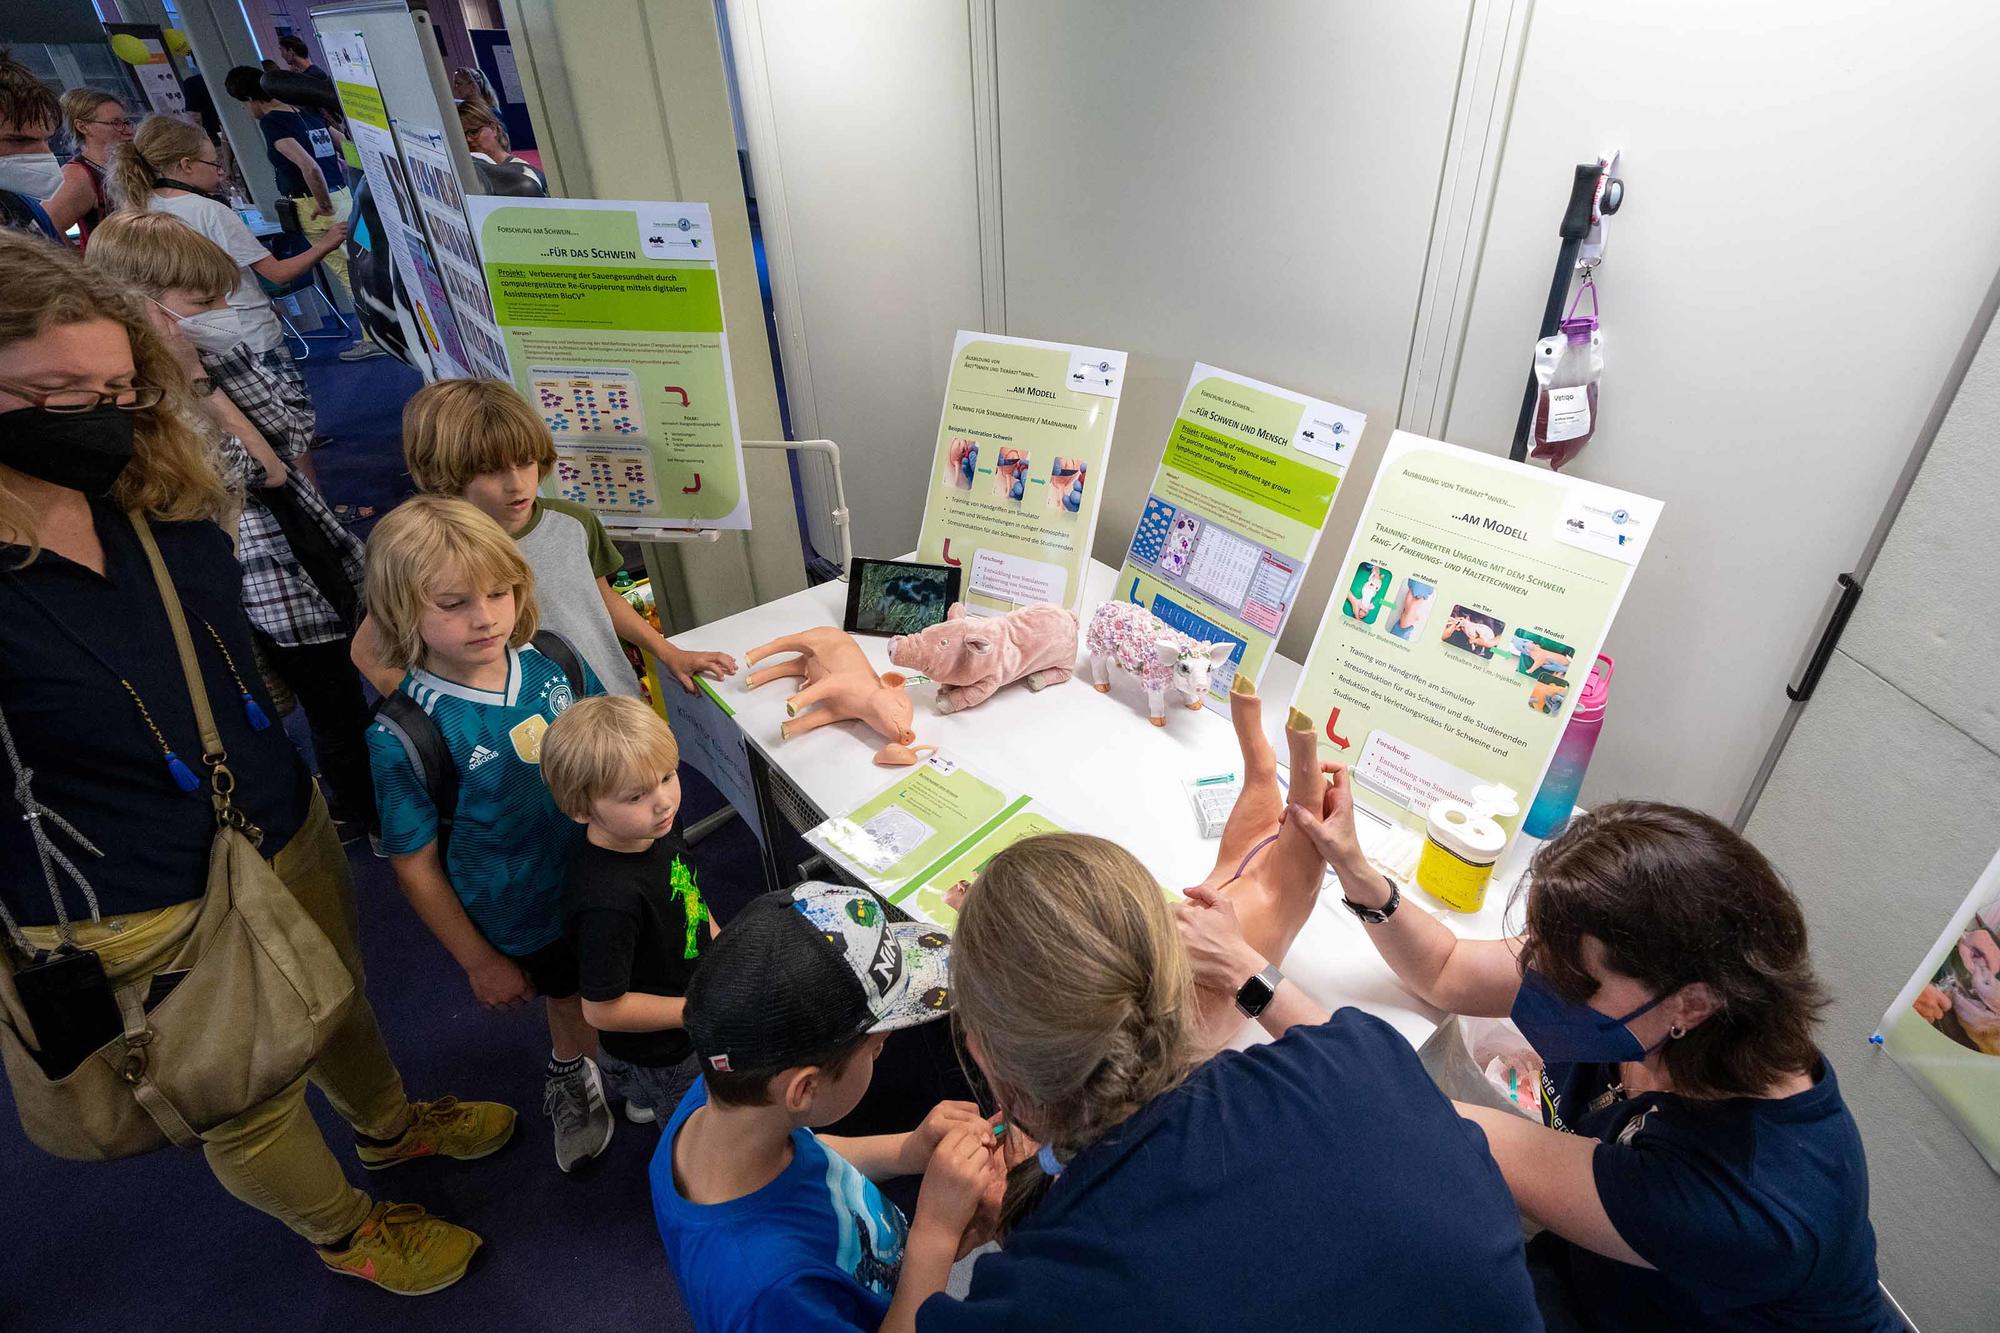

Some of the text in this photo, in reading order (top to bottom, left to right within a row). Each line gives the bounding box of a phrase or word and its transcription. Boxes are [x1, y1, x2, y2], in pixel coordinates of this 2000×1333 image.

[570, 250, 589, 258] DAS
[591, 248, 636, 260] SCHWEIN
[498, 269, 677, 282] Projekt: Verbesserung der Sauengesundheit durch
[501, 280, 687, 293] computergestützte Re-Gruppierung mittels digitalem
[503, 290, 559, 300] Assistenzsystem
[1027, 387, 1056, 399] MODELL
[952, 403, 975, 413] TRAINING
[975, 407, 986, 415] FÜR
[948, 424, 1013, 441] Beispiel: Kastration Schwein
[1209, 411, 1240, 429] SCHWEIN
[1240, 423, 1256, 435] UND
[1256, 428, 1288, 447] MENSCH
[1179, 434, 1187, 442] for
[1187, 437, 1204, 450] porcine
[1205, 445, 1231, 461] neutrophil
[1181, 424, 1200, 438] Projekt:
[1200, 431, 1229, 449] Establishing
[1235, 445, 1260, 460] reference
[1259, 454, 1277, 466] values
[1175, 443, 1292, 495] lymphocyte ratio regarding different age groups
[1402, 469, 1440, 486] AUSBILDUNG
[1440, 480, 1454, 490] VON
[951, 496, 970, 506] Training
[980, 503, 1008, 513] Handgriffen
[1016, 510, 1040, 520] Simulator
[947, 519, 983, 531] Stressreduktion
[1000, 530, 1021, 540] Schwein
[949, 508, 966, 517] Lernen
[976, 513, 1015, 527] Wiederholungen
[1021, 523, 1039, 532] ruhiger
[1482, 518, 1528, 541] MODELL
[1370, 534, 1529, 597] FANG- / FIXIERUNGS- UND HALTETECHNIKEN
[1375, 522, 1566, 595] TRAINING: KORREKTER UMGANG MIT DEM SCHWEIN
[1420, 574, 1438, 585] Modell
[1481, 605, 1493, 613] Tier
[1544, 628, 1565, 640] Modell
[1349, 646, 1476, 707] Training von Handgriffen am Simulator
[1333, 688, 1371, 711] Studierende
[1343, 660, 1528, 748] Stressreduktion für das Schwein und die Studierenden
[1338, 674, 1509, 758] Reduktion des Verletzungsrisikos für Schweine und
[469, 750, 499, 770] adidas
[1375, 738, 1411, 761] Forschung:
[1375, 765, 1426, 797] Evaluierung von
[1379, 756, 1418, 782] Entwicklung
[1419, 777, 1432, 788] von
[1431, 783, 1473, 808] Simulatoren
[1414, 798, 1427, 809] von
